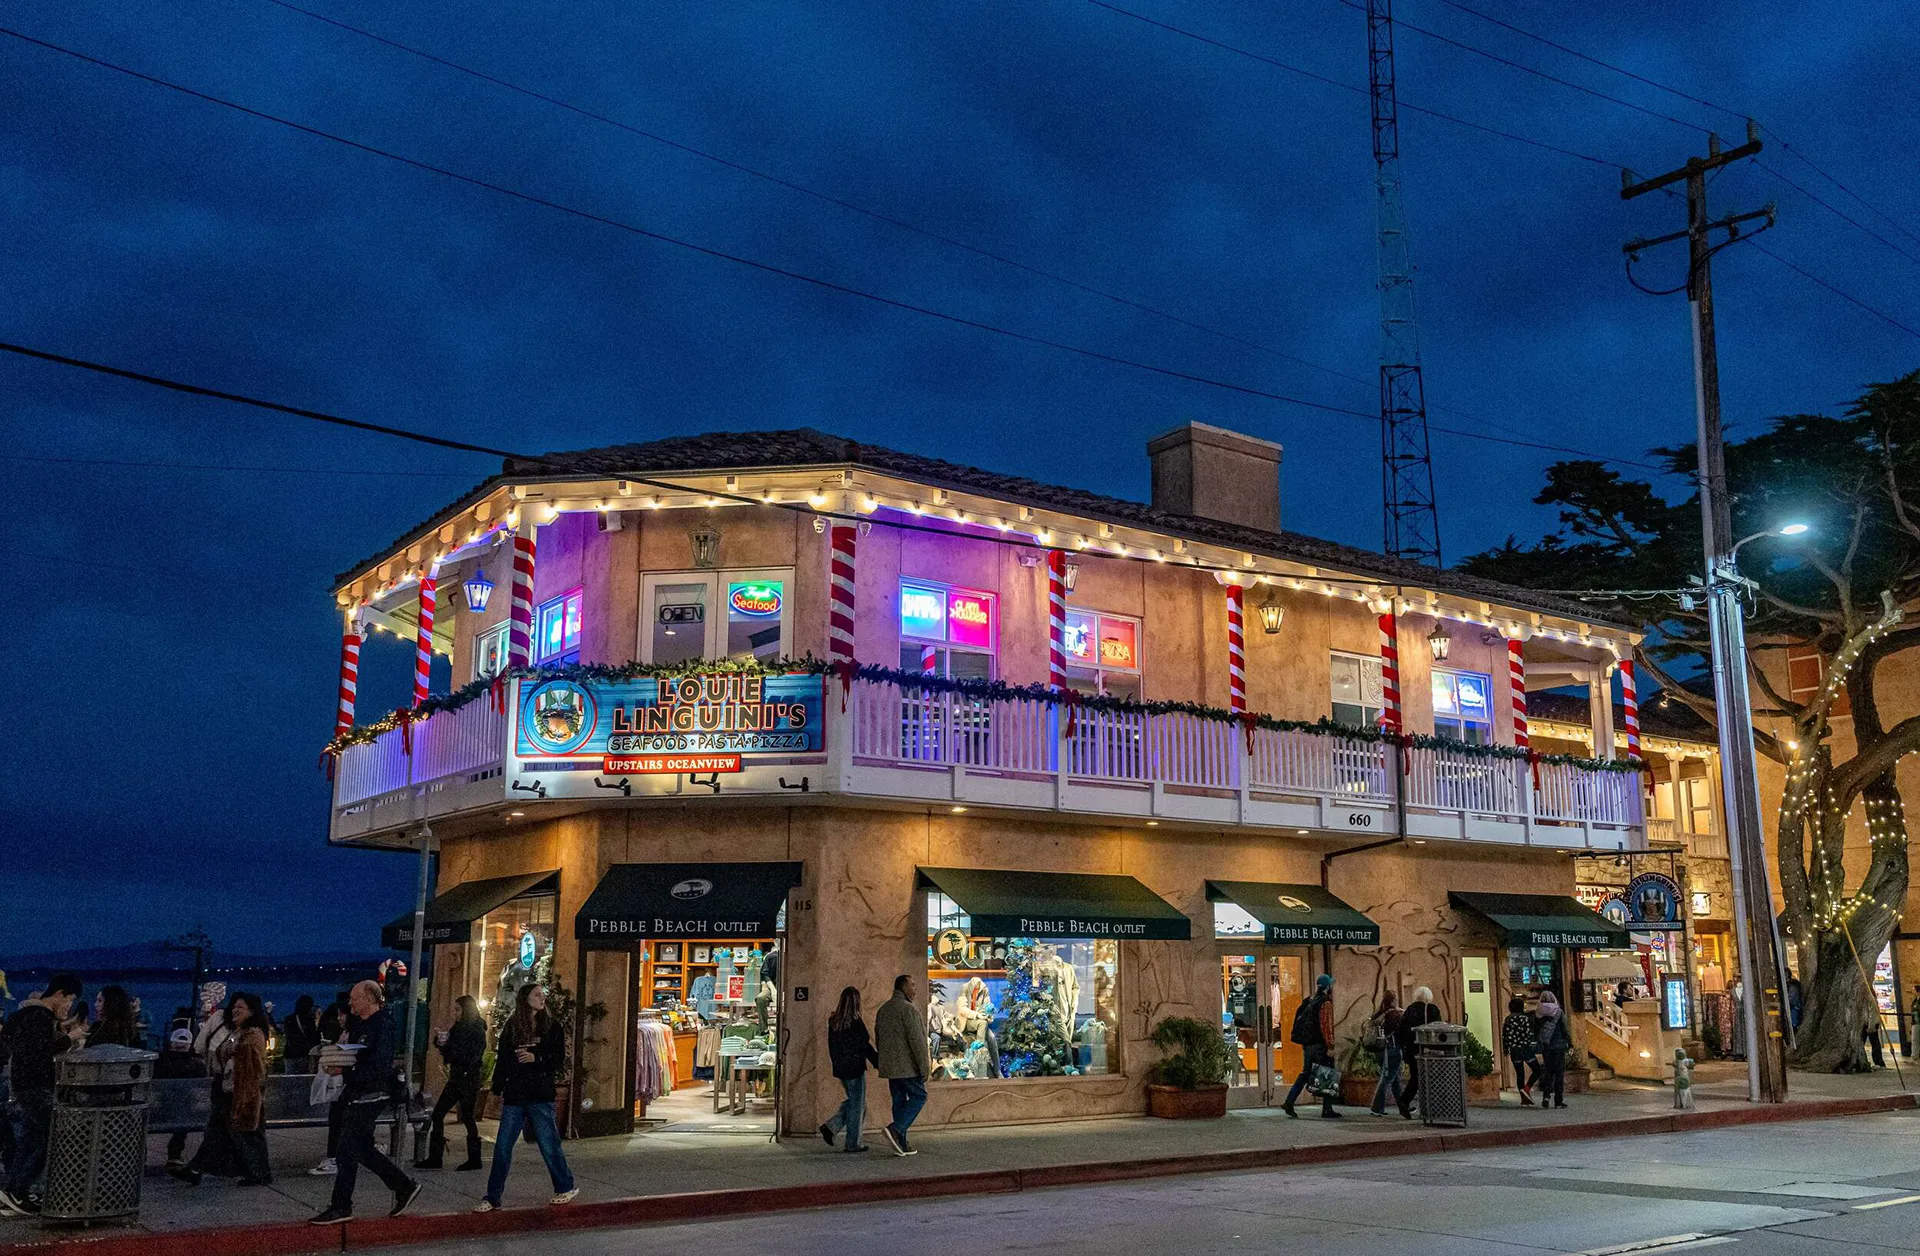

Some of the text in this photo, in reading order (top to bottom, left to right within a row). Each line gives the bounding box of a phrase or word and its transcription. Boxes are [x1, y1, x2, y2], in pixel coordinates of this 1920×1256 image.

[734, 594, 778, 611] Seafood
[660, 607, 703, 622] OPEN
[657, 676, 763, 705] LOUIE
[612, 703, 808, 734] LINGUINI'S
[610, 734, 804, 751] SEAFOOD PASTA PIZZA
[608, 757, 736, 771] UPSTAIRS OCEANVIEW
[1348, 813, 1371, 828] 660
[1624, 877, 1643, 903] LOUIE
[795, 900, 812, 911] 115
[589, 918, 761, 933] PEBBLE BEACH OUTLET
[1020, 918, 1146, 935] PEBBLE BEACH OUTLET
[1273, 926, 1373, 941] PEBBLE BEACH OUTLET
[1532, 932, 1609, 944] PEBBLE BEACH OUTLET
